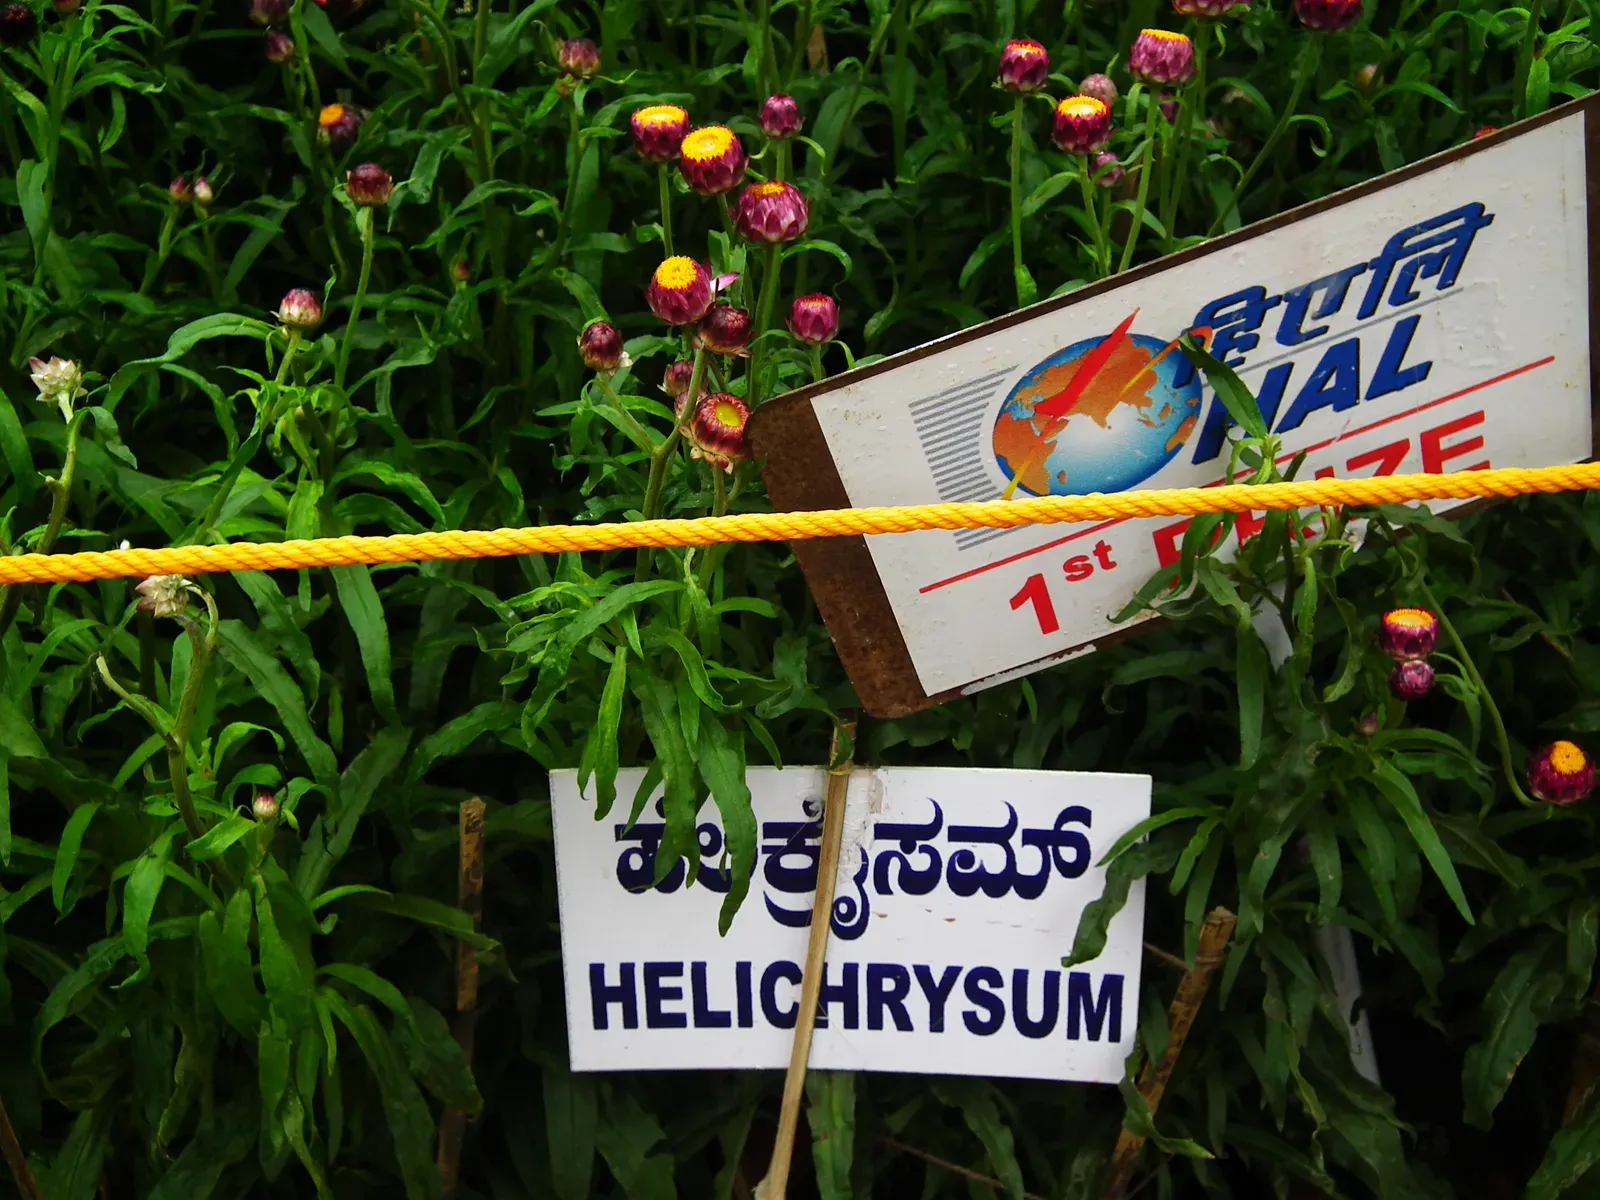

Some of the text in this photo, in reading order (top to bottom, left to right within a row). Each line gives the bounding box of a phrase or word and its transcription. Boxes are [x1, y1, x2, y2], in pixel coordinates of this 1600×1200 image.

[1191, 314, 1433, 466] HAL
[1009, 539, 1117, 636] 1st
[588, 960, 1125, 1043] HELICHRYSUM
